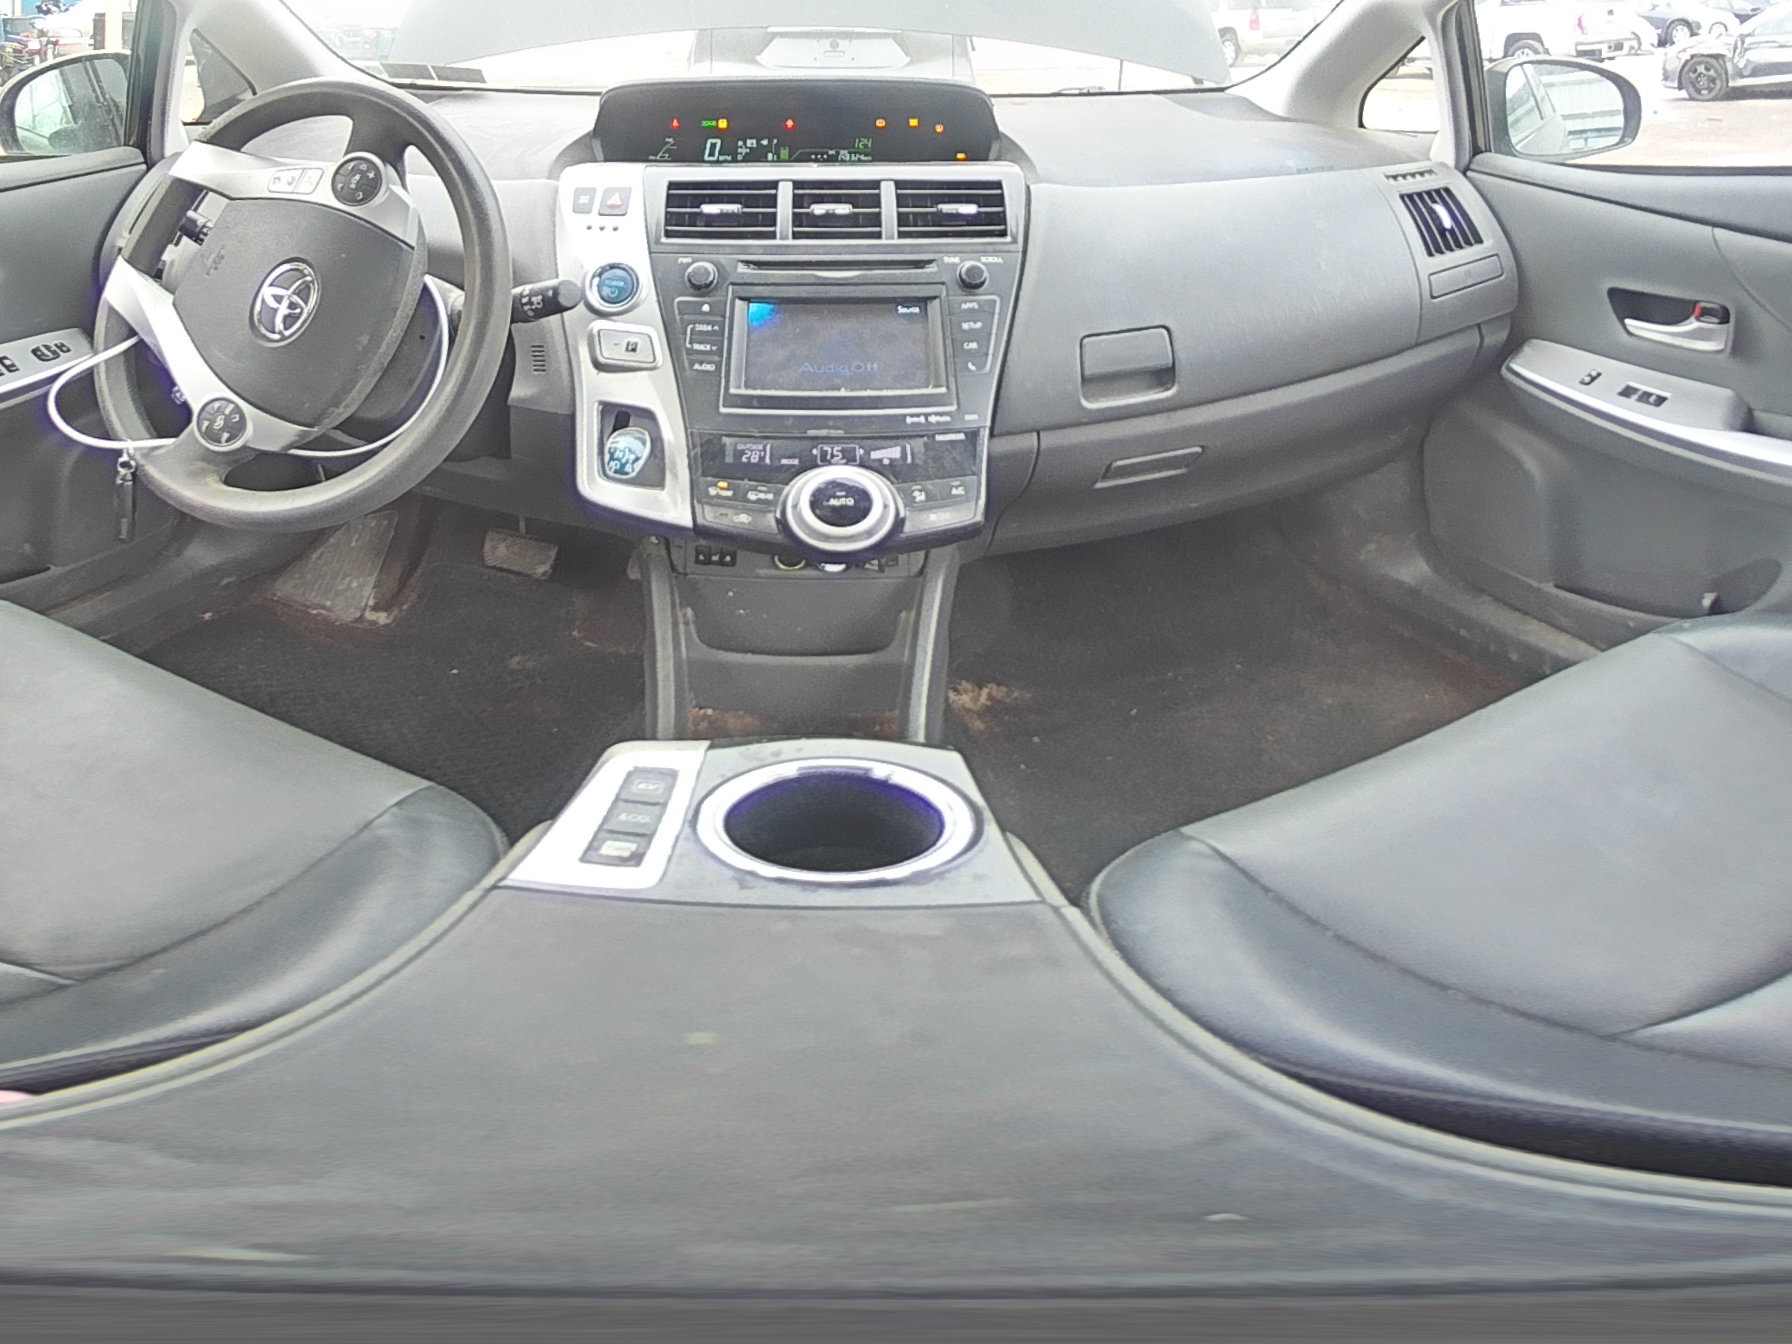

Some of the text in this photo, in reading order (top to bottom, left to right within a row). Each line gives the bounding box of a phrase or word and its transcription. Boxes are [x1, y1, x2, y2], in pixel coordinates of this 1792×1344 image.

[703, 137, 722, 161] 0
[798, 360, 879, 375] Audio Off
[822, 446, 843, 461] 75
[828, 497, 855, 506] AUTO
